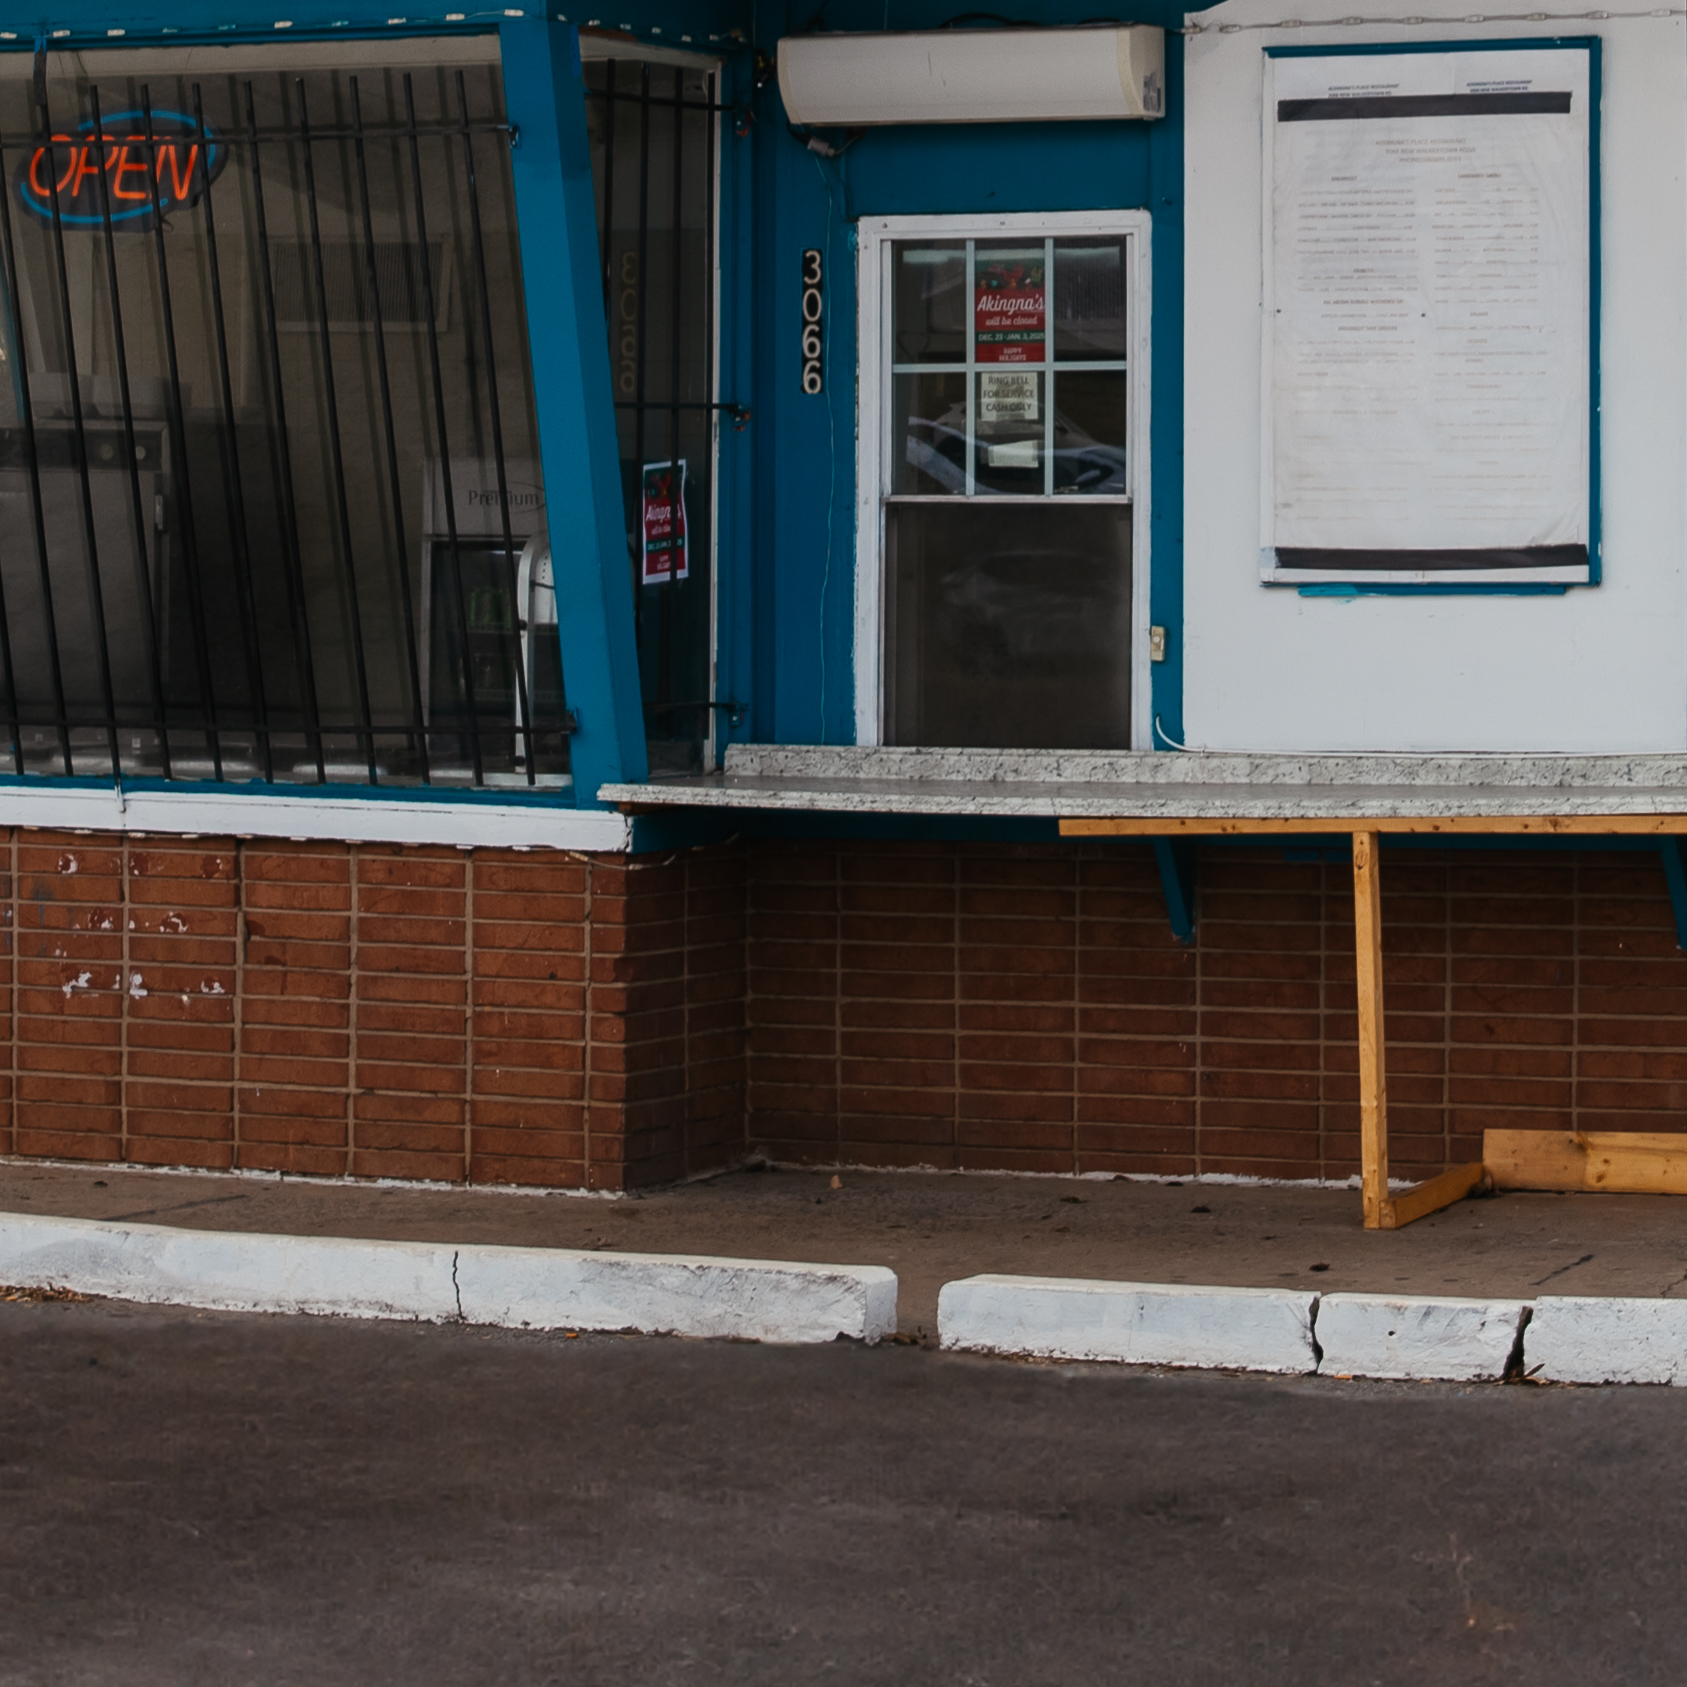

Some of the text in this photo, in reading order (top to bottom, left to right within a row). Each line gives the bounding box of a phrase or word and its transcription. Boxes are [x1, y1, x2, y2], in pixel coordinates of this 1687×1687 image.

[30, 134, 198, 201] OPEN
[977, 294, 1045, 316] Akingna's
[802, 250, 822, 394] 3066
[988, 376, 1029, 385] RING BELL
[983, 389, 1035, 399] FOR SERVICE
[986, 402, 1032, 412] CASH ONLY
